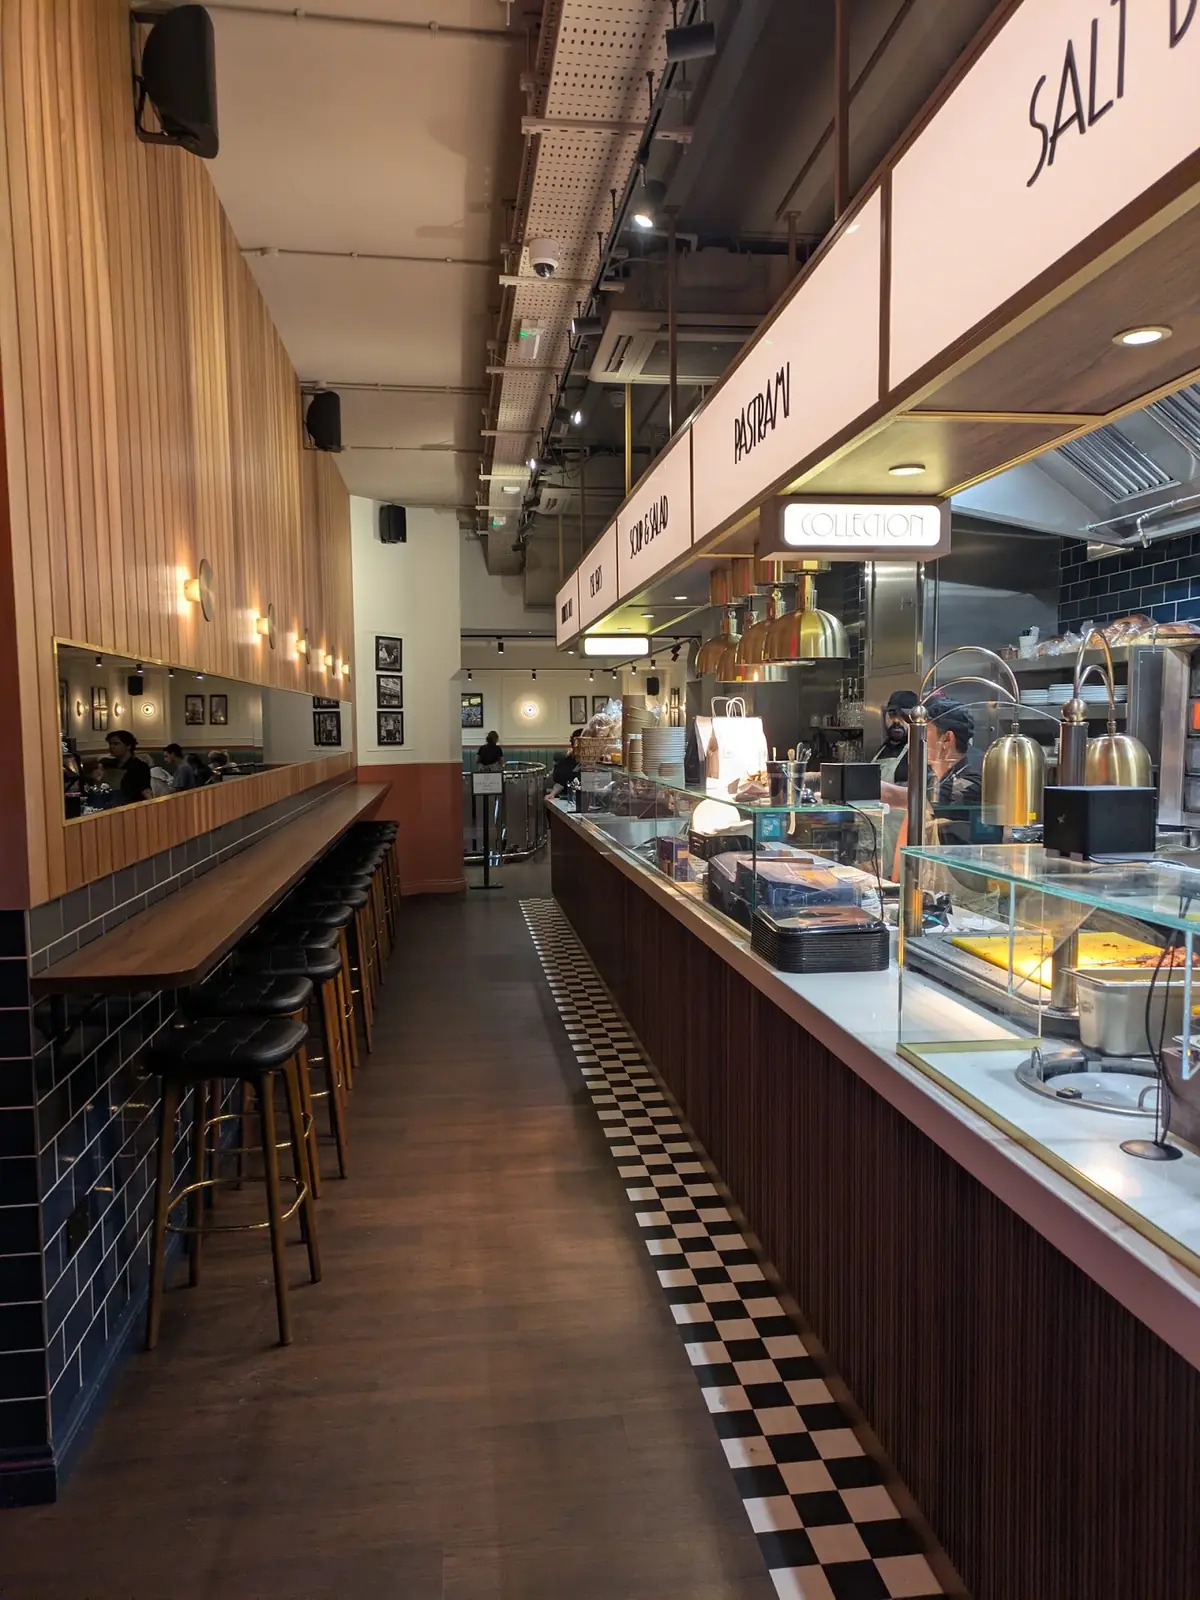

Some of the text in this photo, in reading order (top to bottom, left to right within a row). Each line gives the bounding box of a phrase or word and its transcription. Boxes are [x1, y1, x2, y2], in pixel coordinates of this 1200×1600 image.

[1026, 0, 1127, 187] SALT
[734, 361, 790, 464] PASTRAMI
[629, 495, 669, 560] SOUP & SALAD
[801, 512, 924, 538] COLLECTION
